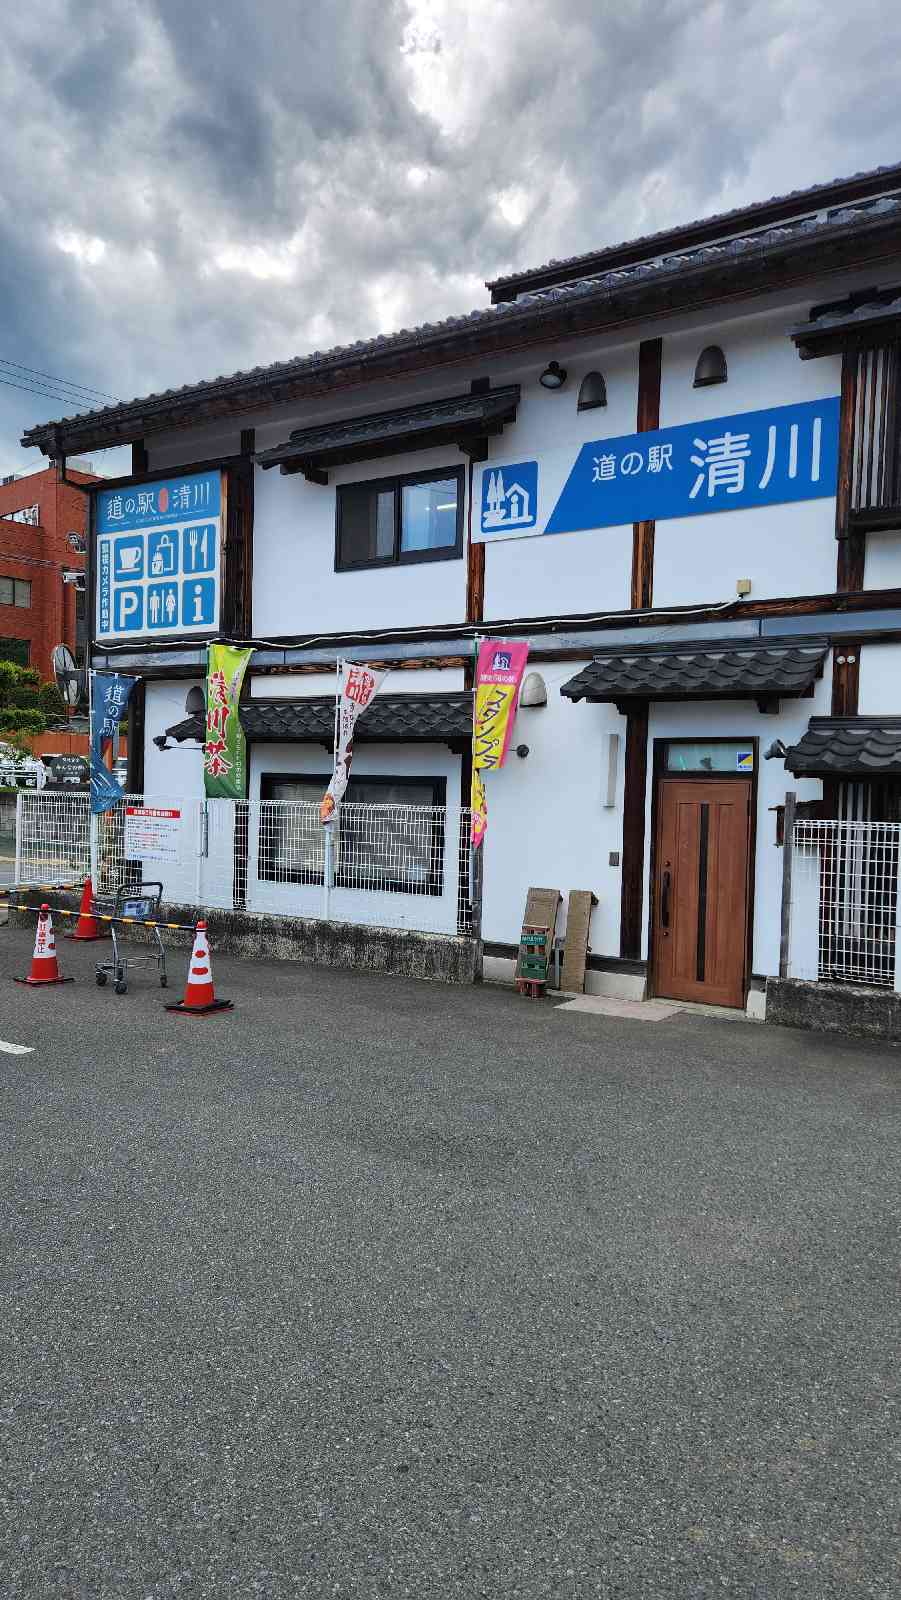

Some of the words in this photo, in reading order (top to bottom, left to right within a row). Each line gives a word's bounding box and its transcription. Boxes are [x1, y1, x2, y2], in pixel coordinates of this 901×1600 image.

[591, 443, 673, 483] 道の駅
[689, 417, 822, 499] 清川
[107, 491, 157, 521] 道の駅
[173, 481, 210, 510] 清川
[119, 591, 138, 628] P
